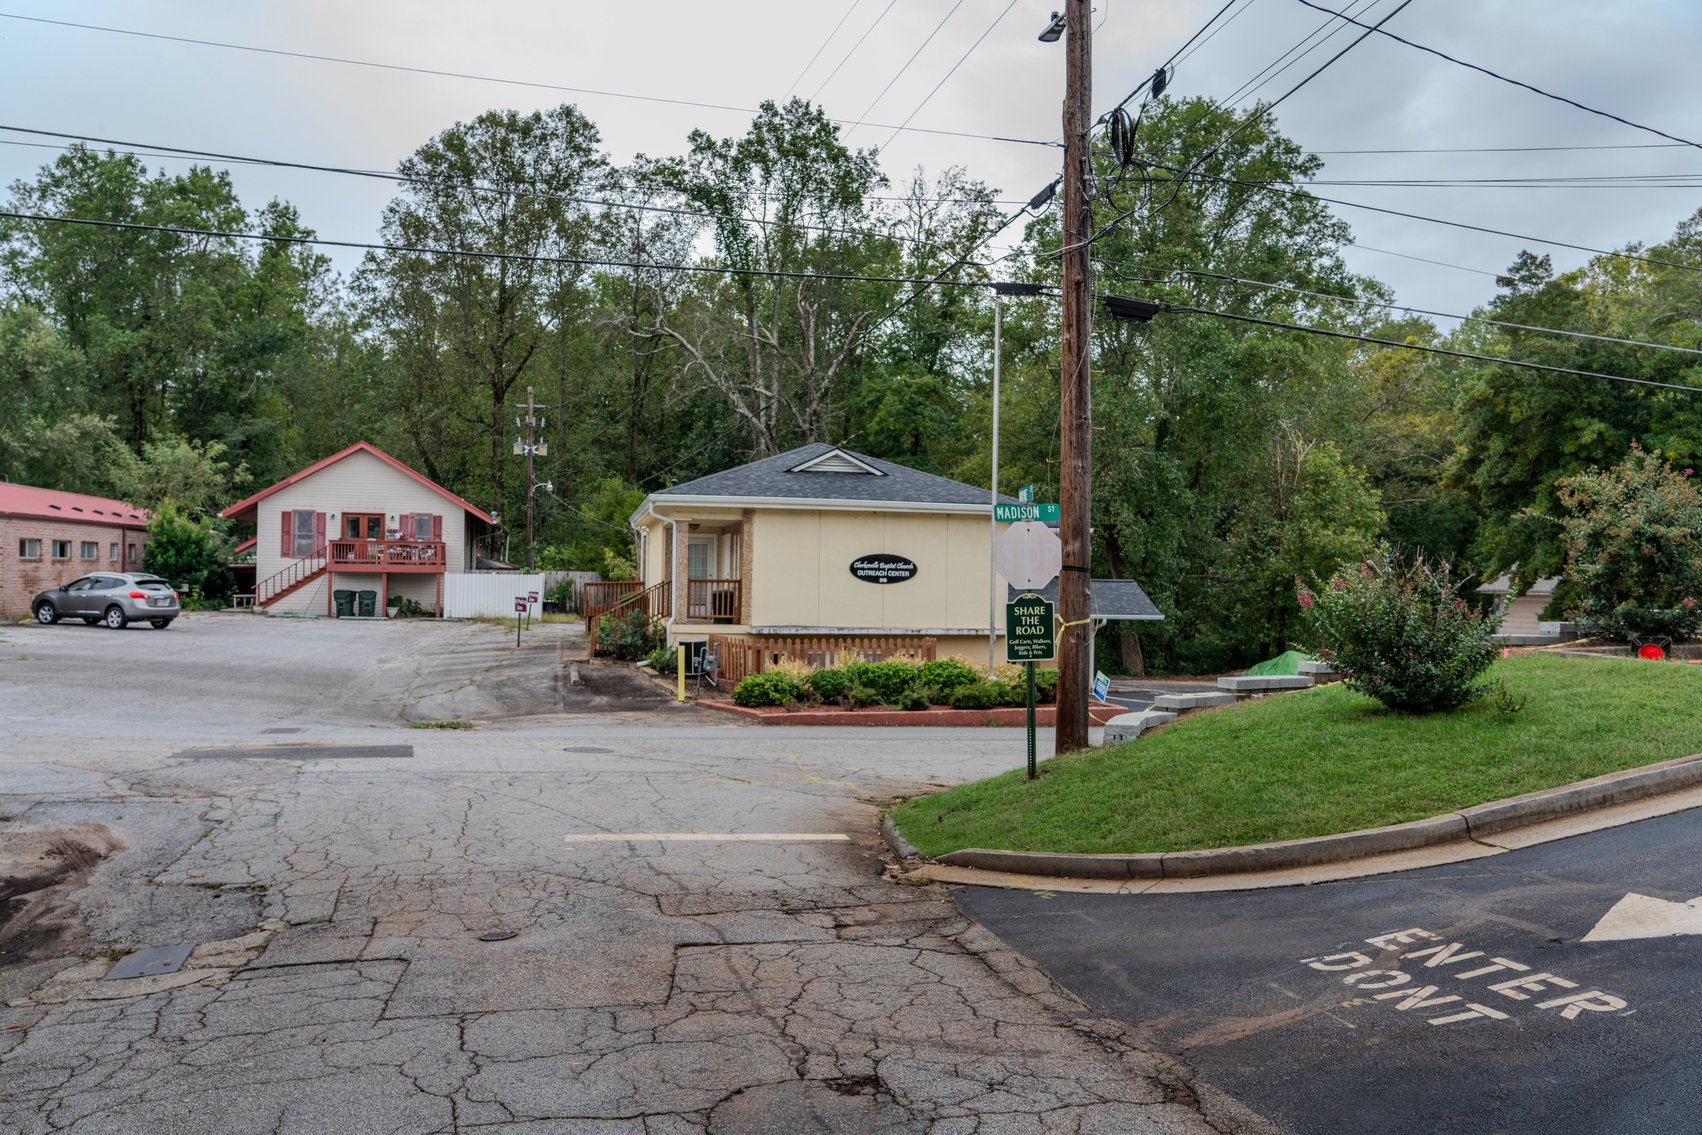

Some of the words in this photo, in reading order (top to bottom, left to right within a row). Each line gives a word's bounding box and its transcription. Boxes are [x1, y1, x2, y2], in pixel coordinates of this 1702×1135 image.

[997, 506, 1040, 520] MADISON
[1047, 505, 1055, 513] ST
[1002, 543, 1057, 569] STOP
[879, 562, 897, 571] Baptist
[896, 561, 914, 569] Church
[1014, 606, 1046, 616] SHARE
[1020, 616, 1040, 625] THE
[1016, 626, 1045, 635] ROAD
[1364, 927, 1627, 1020] ENTER
